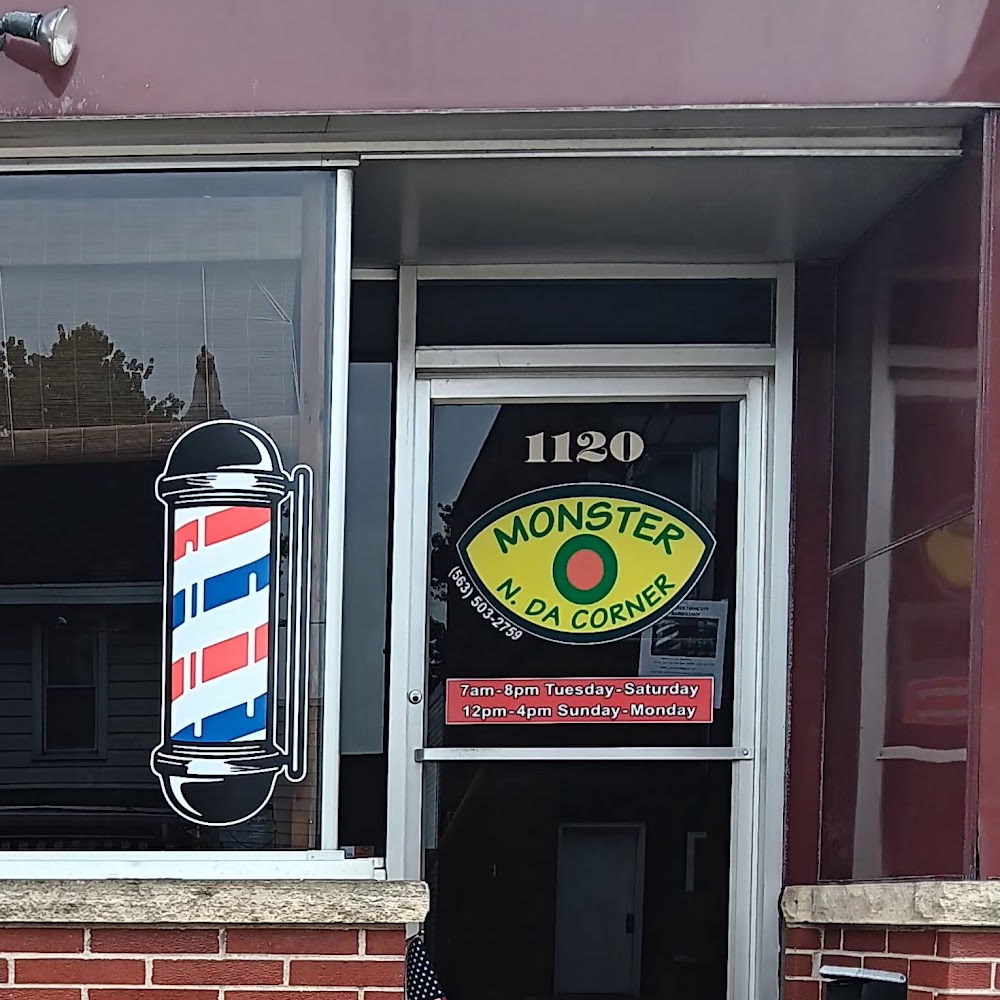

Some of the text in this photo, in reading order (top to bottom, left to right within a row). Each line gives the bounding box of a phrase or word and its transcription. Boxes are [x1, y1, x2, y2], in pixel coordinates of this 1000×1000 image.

[524, 430, 645, 463] 1120
[493, 501, 685, 555] MONSTER
[448, 565, 523, 642] (563) 503-2759
[496, 577, 522, 606] N.
[524, 598, 560, 627] DA
[571, 573, 676, 630] CORNER
